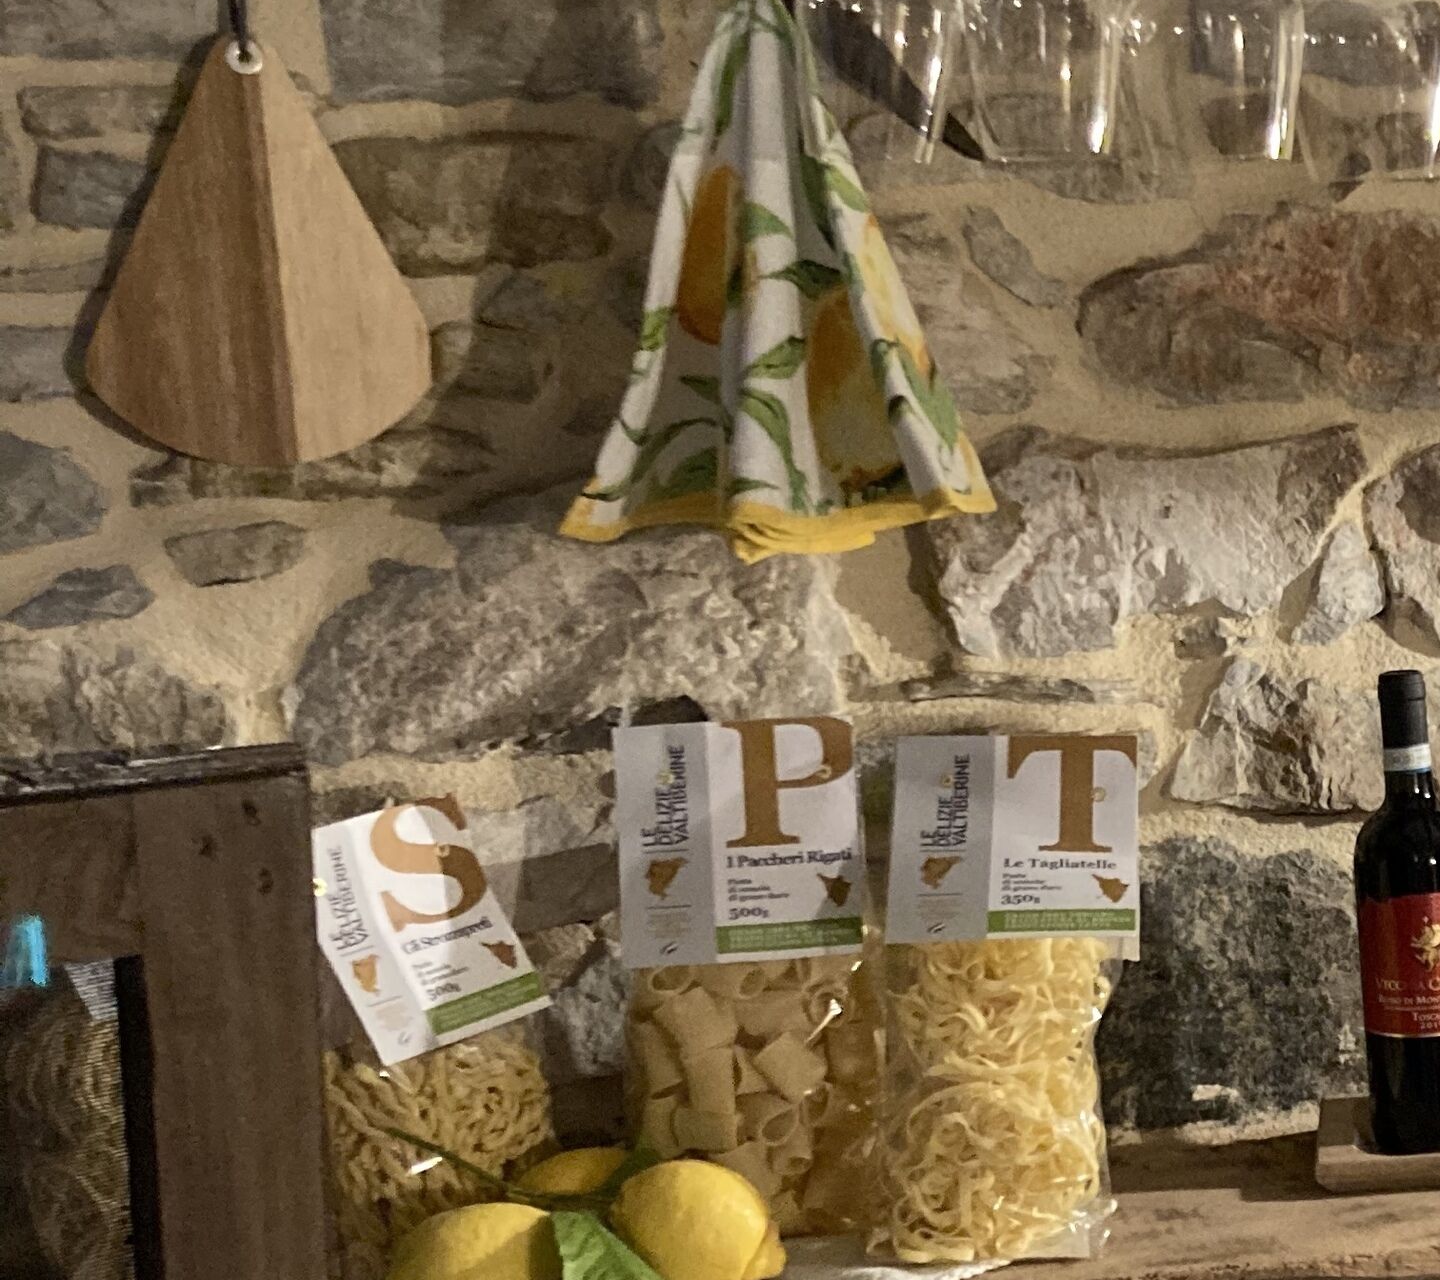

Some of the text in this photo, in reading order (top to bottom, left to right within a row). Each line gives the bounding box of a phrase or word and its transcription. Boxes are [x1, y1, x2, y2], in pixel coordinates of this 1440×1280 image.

[720, 716, 854, 848] P
[1007, 735, 1137, 852] T
[370, 793, 488, 933] S
[737, 851, 804, 869] Paccheri
[1003, 858, 1117, 871] Le Tagliatelle
